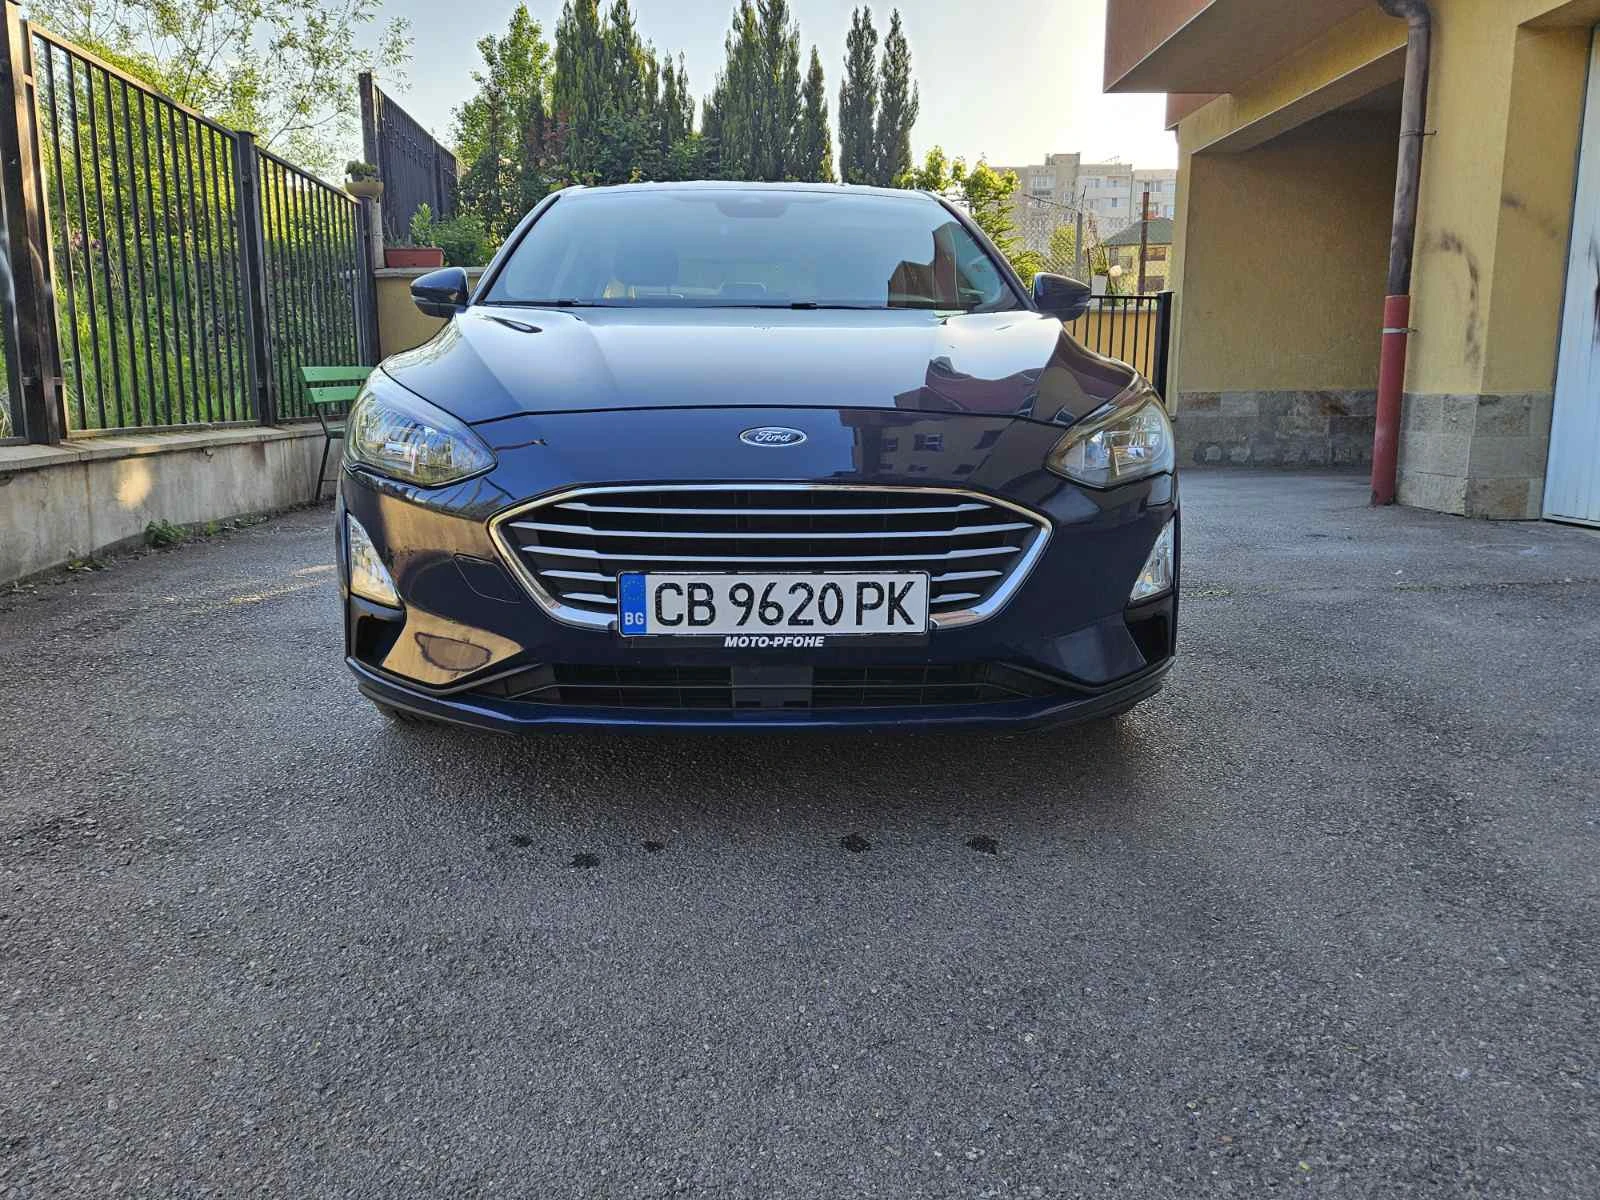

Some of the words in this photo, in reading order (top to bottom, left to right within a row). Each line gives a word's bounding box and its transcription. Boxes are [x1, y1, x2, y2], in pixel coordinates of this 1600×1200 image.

[755, 430, 791, 442] Ford
[654, 582, 716, 626] CB
[729, 582, 844, 626] 9620
[855, 581, 915, 626] PK
[624, 612, 644, 625] BG
[724, 636, 825, 647] MOTO-PFOHE
